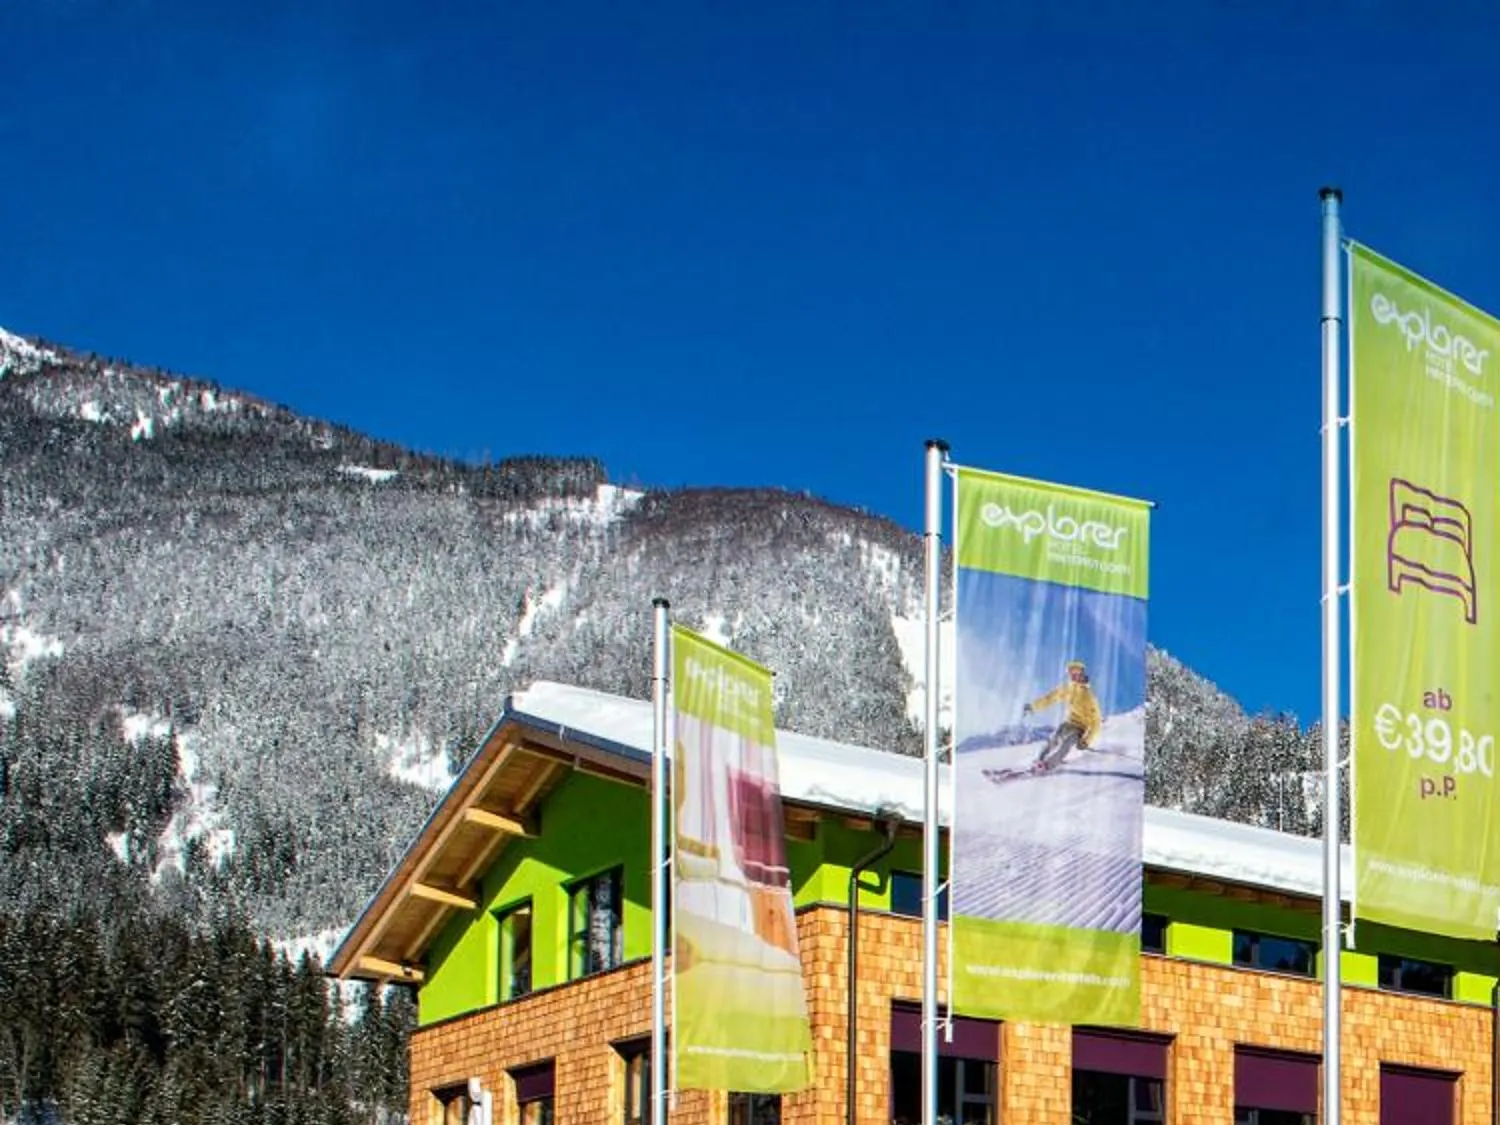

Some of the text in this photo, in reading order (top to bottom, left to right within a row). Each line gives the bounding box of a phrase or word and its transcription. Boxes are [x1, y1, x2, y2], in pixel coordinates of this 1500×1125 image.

[1371, 293, 1489, 375] explorer
[979, 501, 1129, 549] explorer
[1423, 687, 1453, 711] ab
